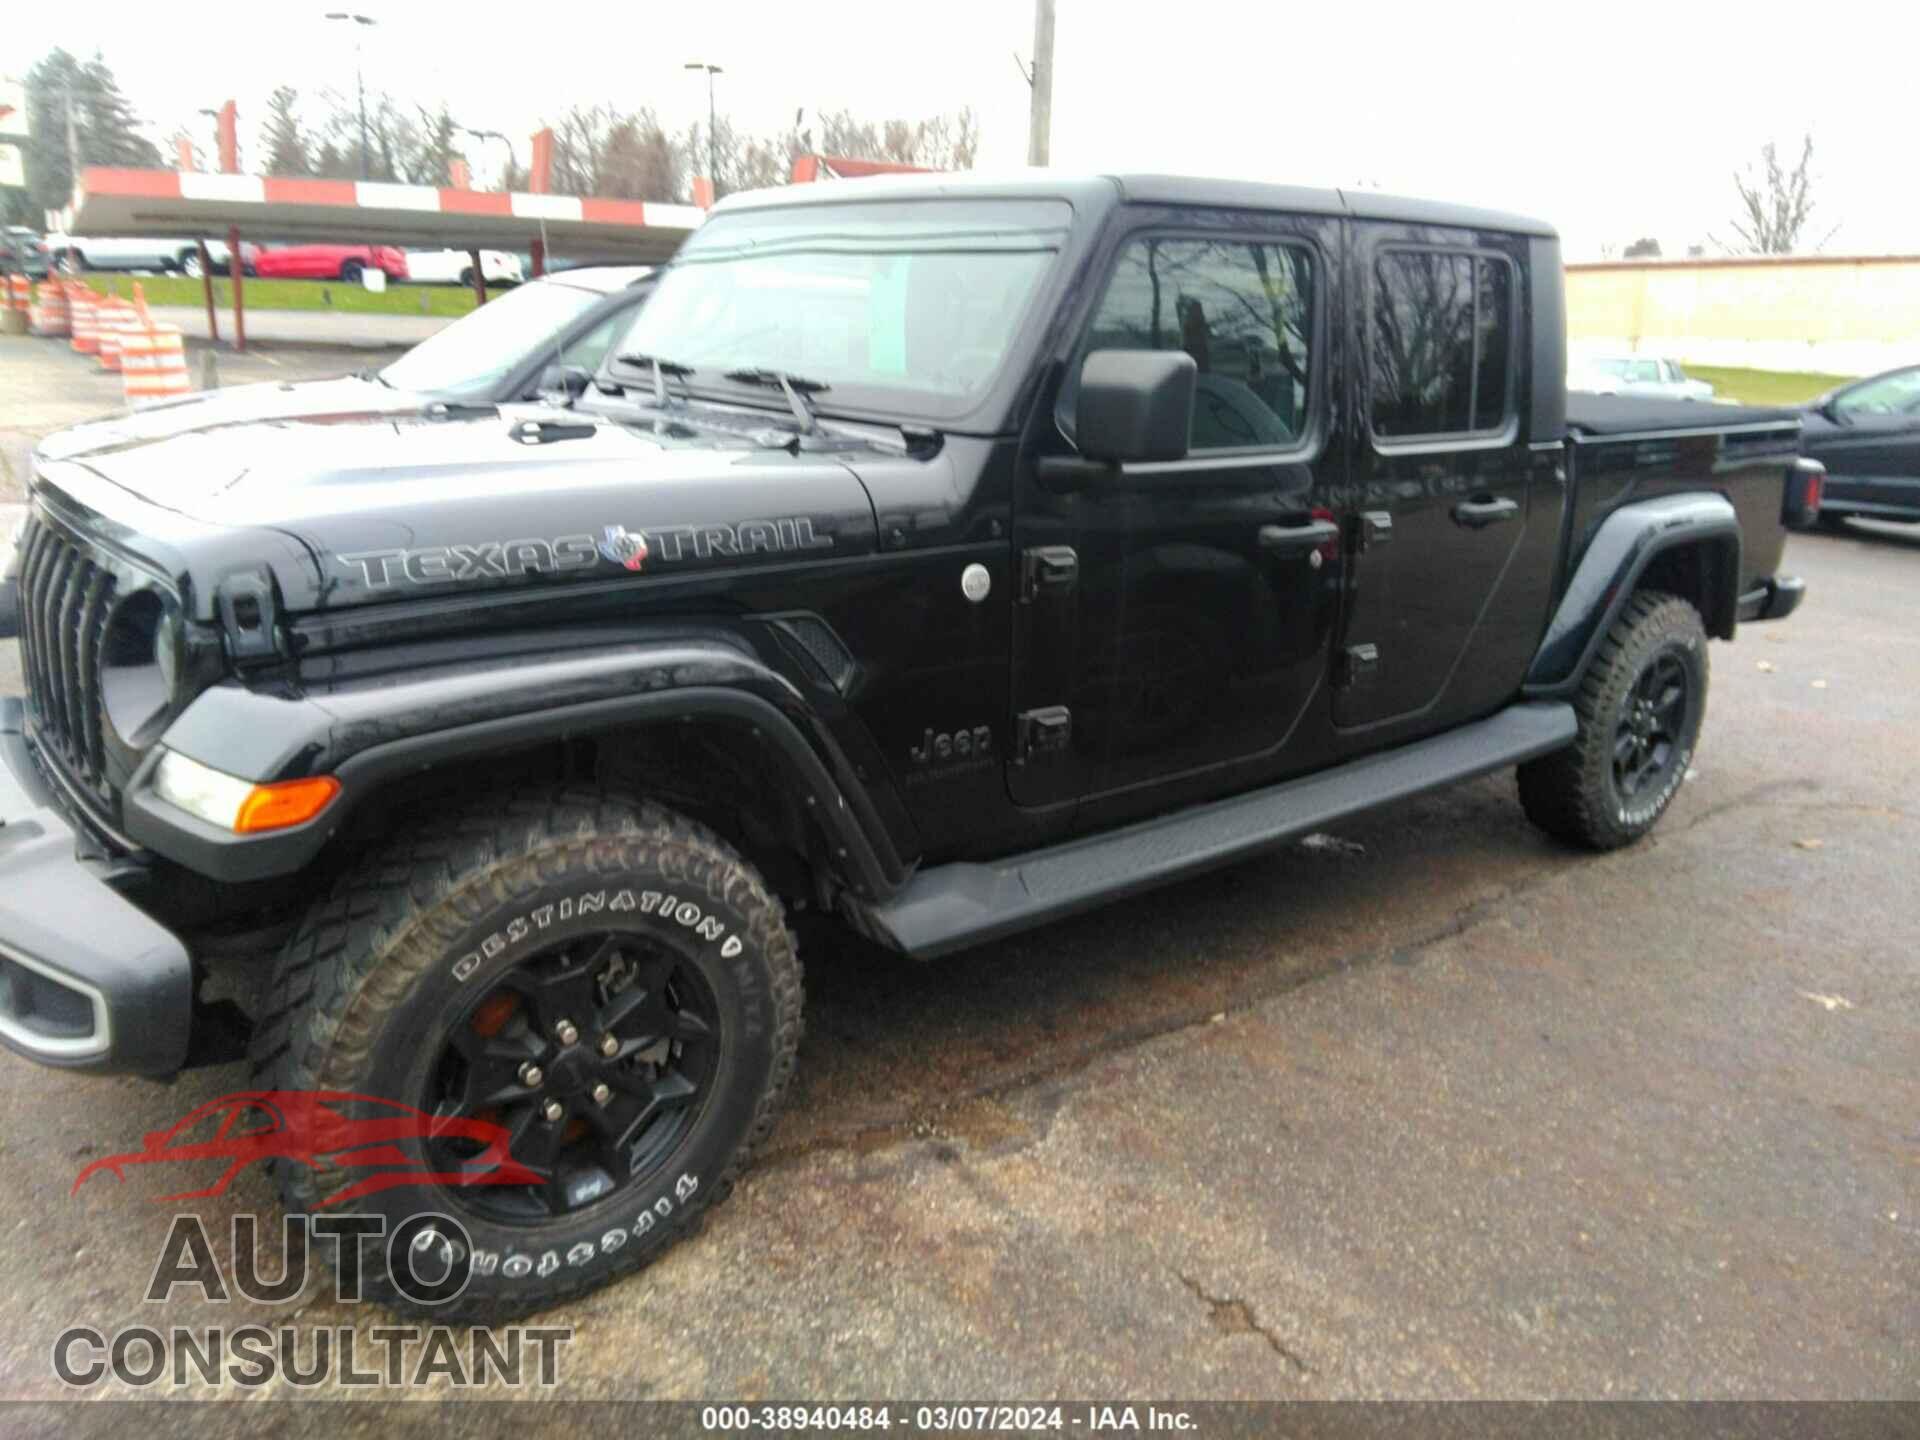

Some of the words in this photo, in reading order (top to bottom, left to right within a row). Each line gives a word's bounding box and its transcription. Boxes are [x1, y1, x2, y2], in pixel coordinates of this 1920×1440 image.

[336, 534, 599, 590] TEXAS
[641, 516, 834, 563] TRAIL
[911, 725, 991, 760] Jeep
[451, 890, 726, 982] DESTINATION
